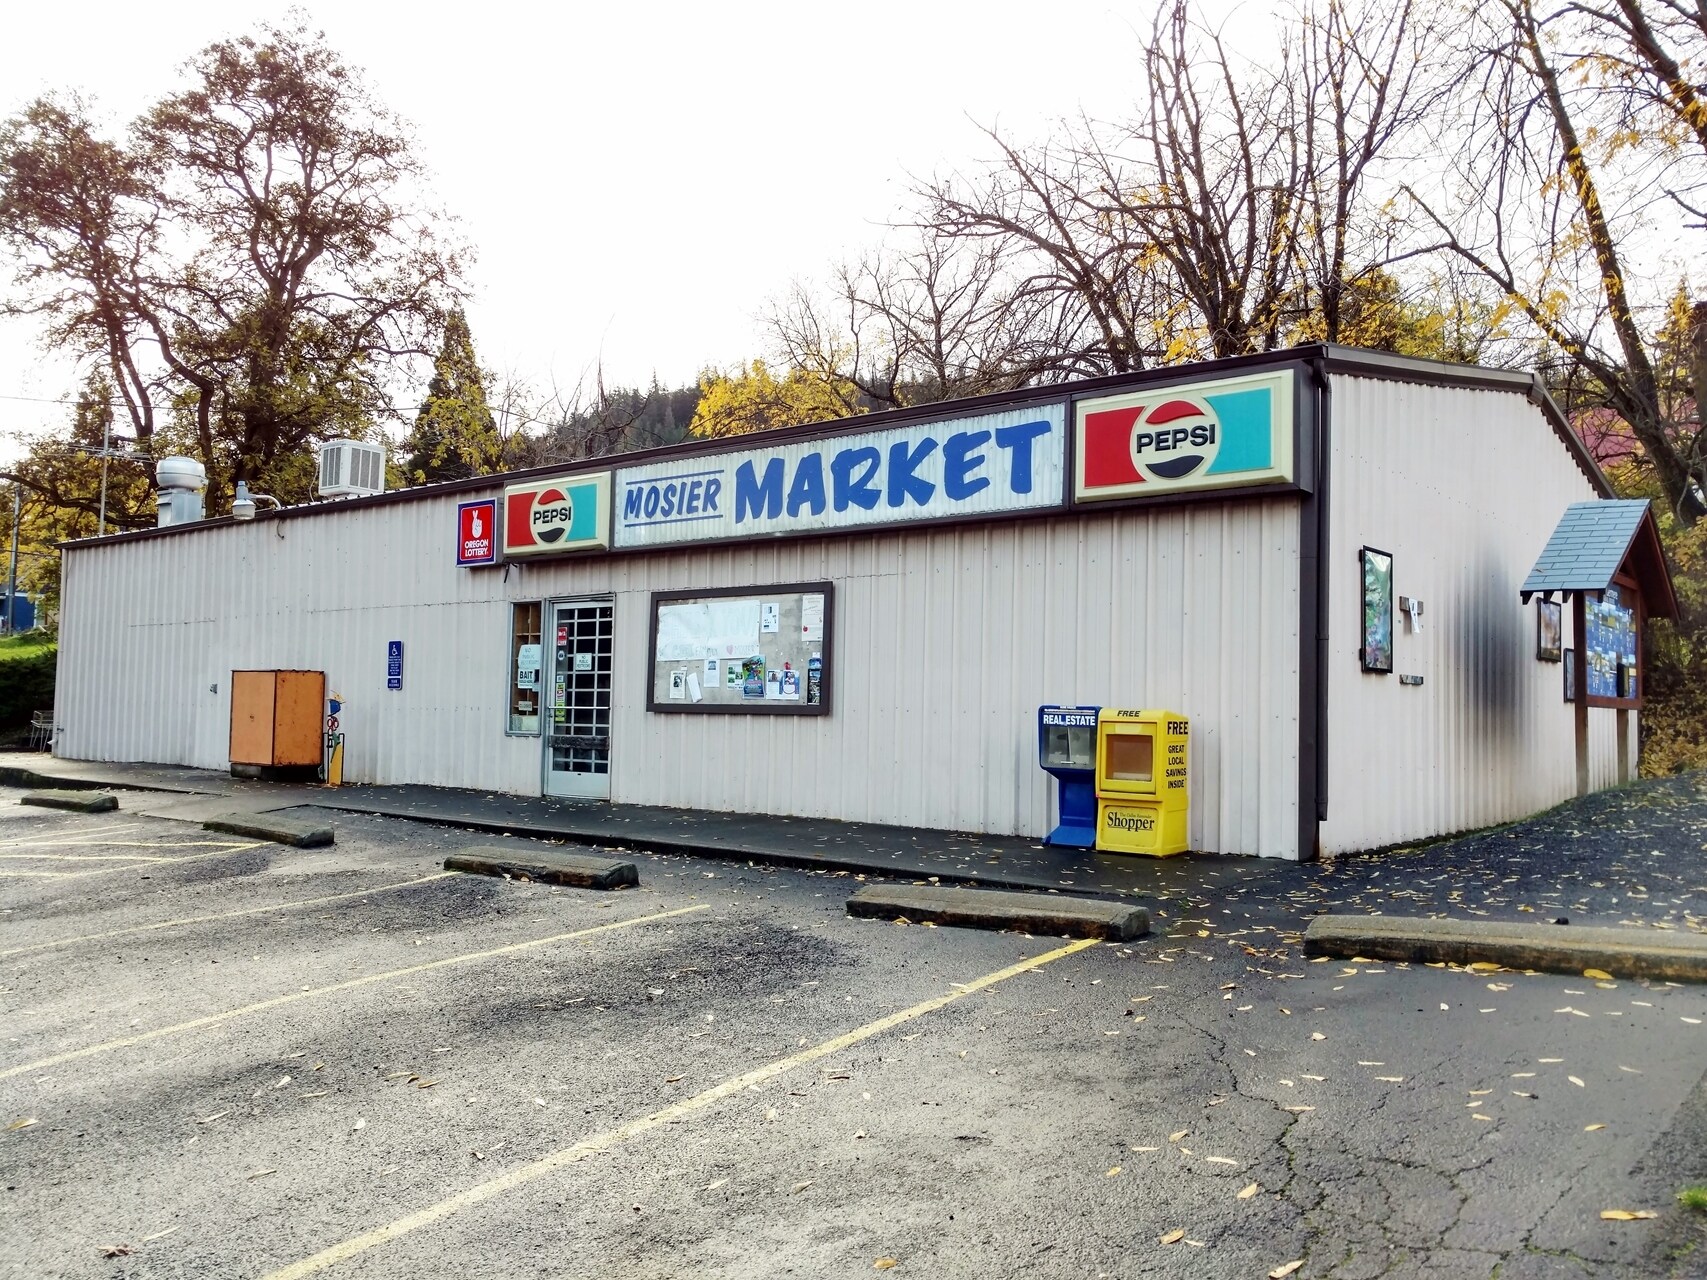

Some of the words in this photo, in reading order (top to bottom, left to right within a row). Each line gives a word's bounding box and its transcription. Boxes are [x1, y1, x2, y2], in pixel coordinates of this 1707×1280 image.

[1136, 423, 1216, 454] PEPSI
[624, 478, 722, 520] MOSIER
[735, 421, 1052, 524] MARKET
[533, 506, 572, 525] PEPSI
[464, 539, 489, 548] OREGON
[464, 547, 488, 557] LOTTERY
[519, 670, 533, 680] BAIT
[1043, 714, 1064, 725] REAL
[1065, 715, 1096, 726] ESTATE
[1167, 721, 1188, 735] FREE
[1168, 745, 1185, 754] GREAT
[1168, 757, 1185, 765] LOCAL
[1165, 767, 1187, 778] SAVINGS
[1167, 780, 1185, 789] INSIDE
[1107, 811, 1155, 832] Shopper
